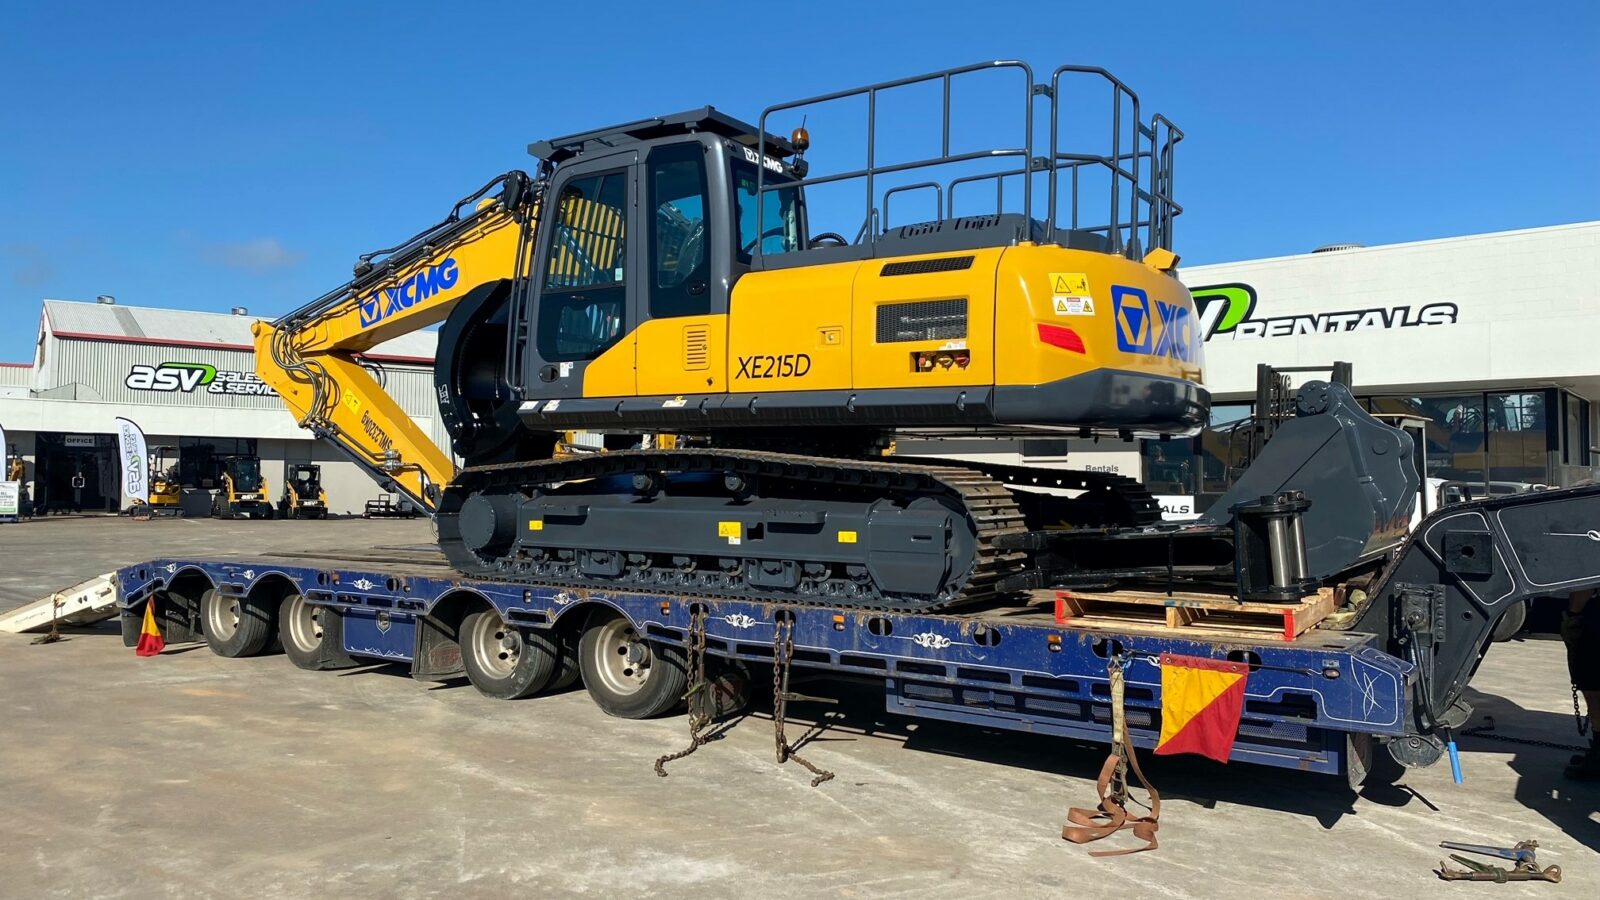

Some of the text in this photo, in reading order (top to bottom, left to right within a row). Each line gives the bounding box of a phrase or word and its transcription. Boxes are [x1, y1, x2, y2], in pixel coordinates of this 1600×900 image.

[382, 257, 459, 319] XCMG
[1233, 303, 1458, 341] RENTALS
[735, 353, 811, 380] XE215D
[208, 381, 281, 395] & SERVIC
[1162, 505, 1190, 514] ALS
